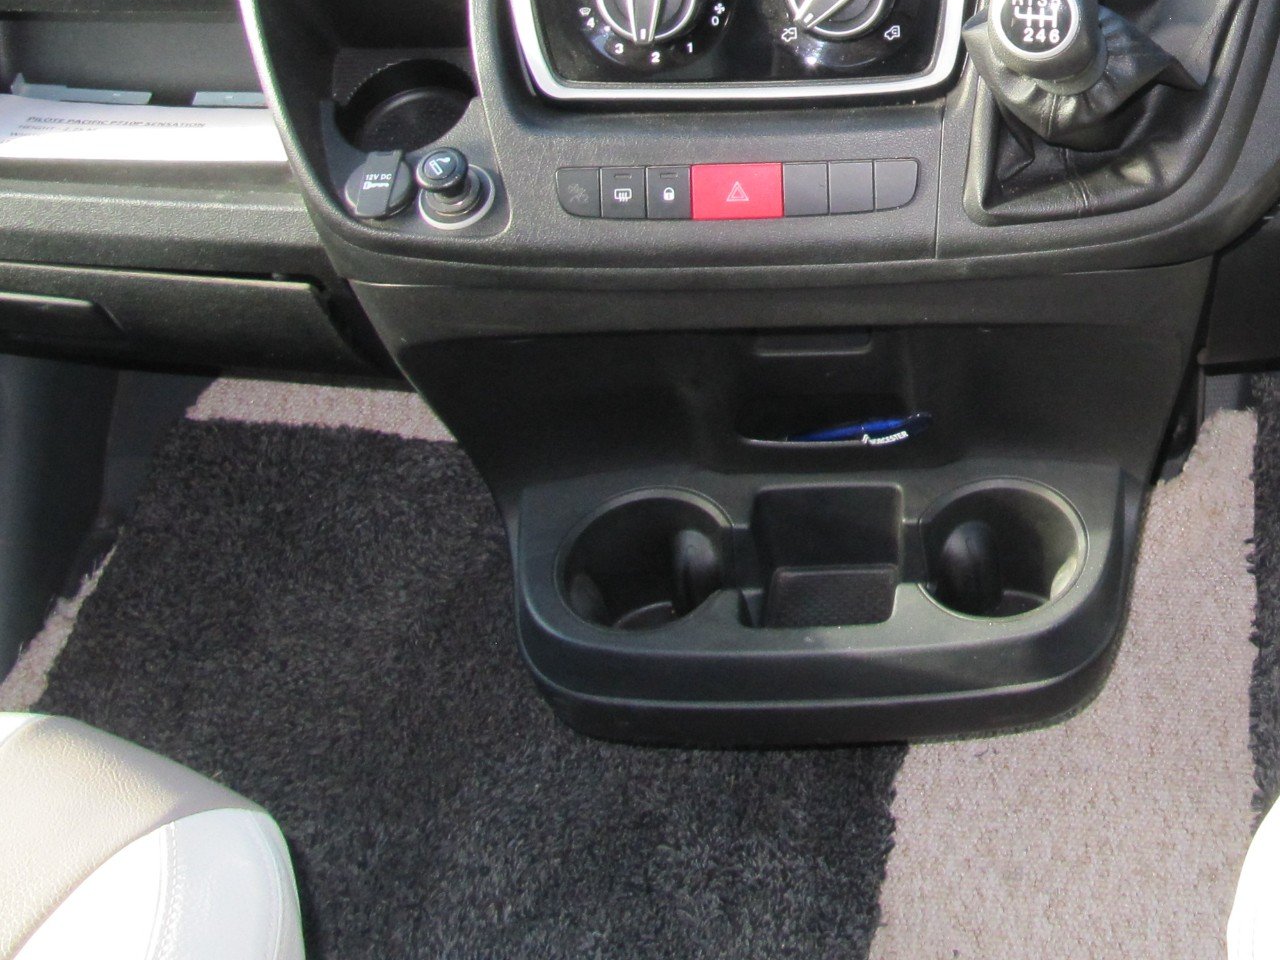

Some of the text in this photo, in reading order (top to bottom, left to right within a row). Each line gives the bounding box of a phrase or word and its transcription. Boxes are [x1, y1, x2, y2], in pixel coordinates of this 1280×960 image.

[586, 17, 595, 28] 4
[711, 16, 720, 26] 0
[1023, 27, 1060, 43] 2 4 6
[614, 42, 624, 54] 3
[686, 42, 694, 53] 1
[651, 51, 661, 63] 2
